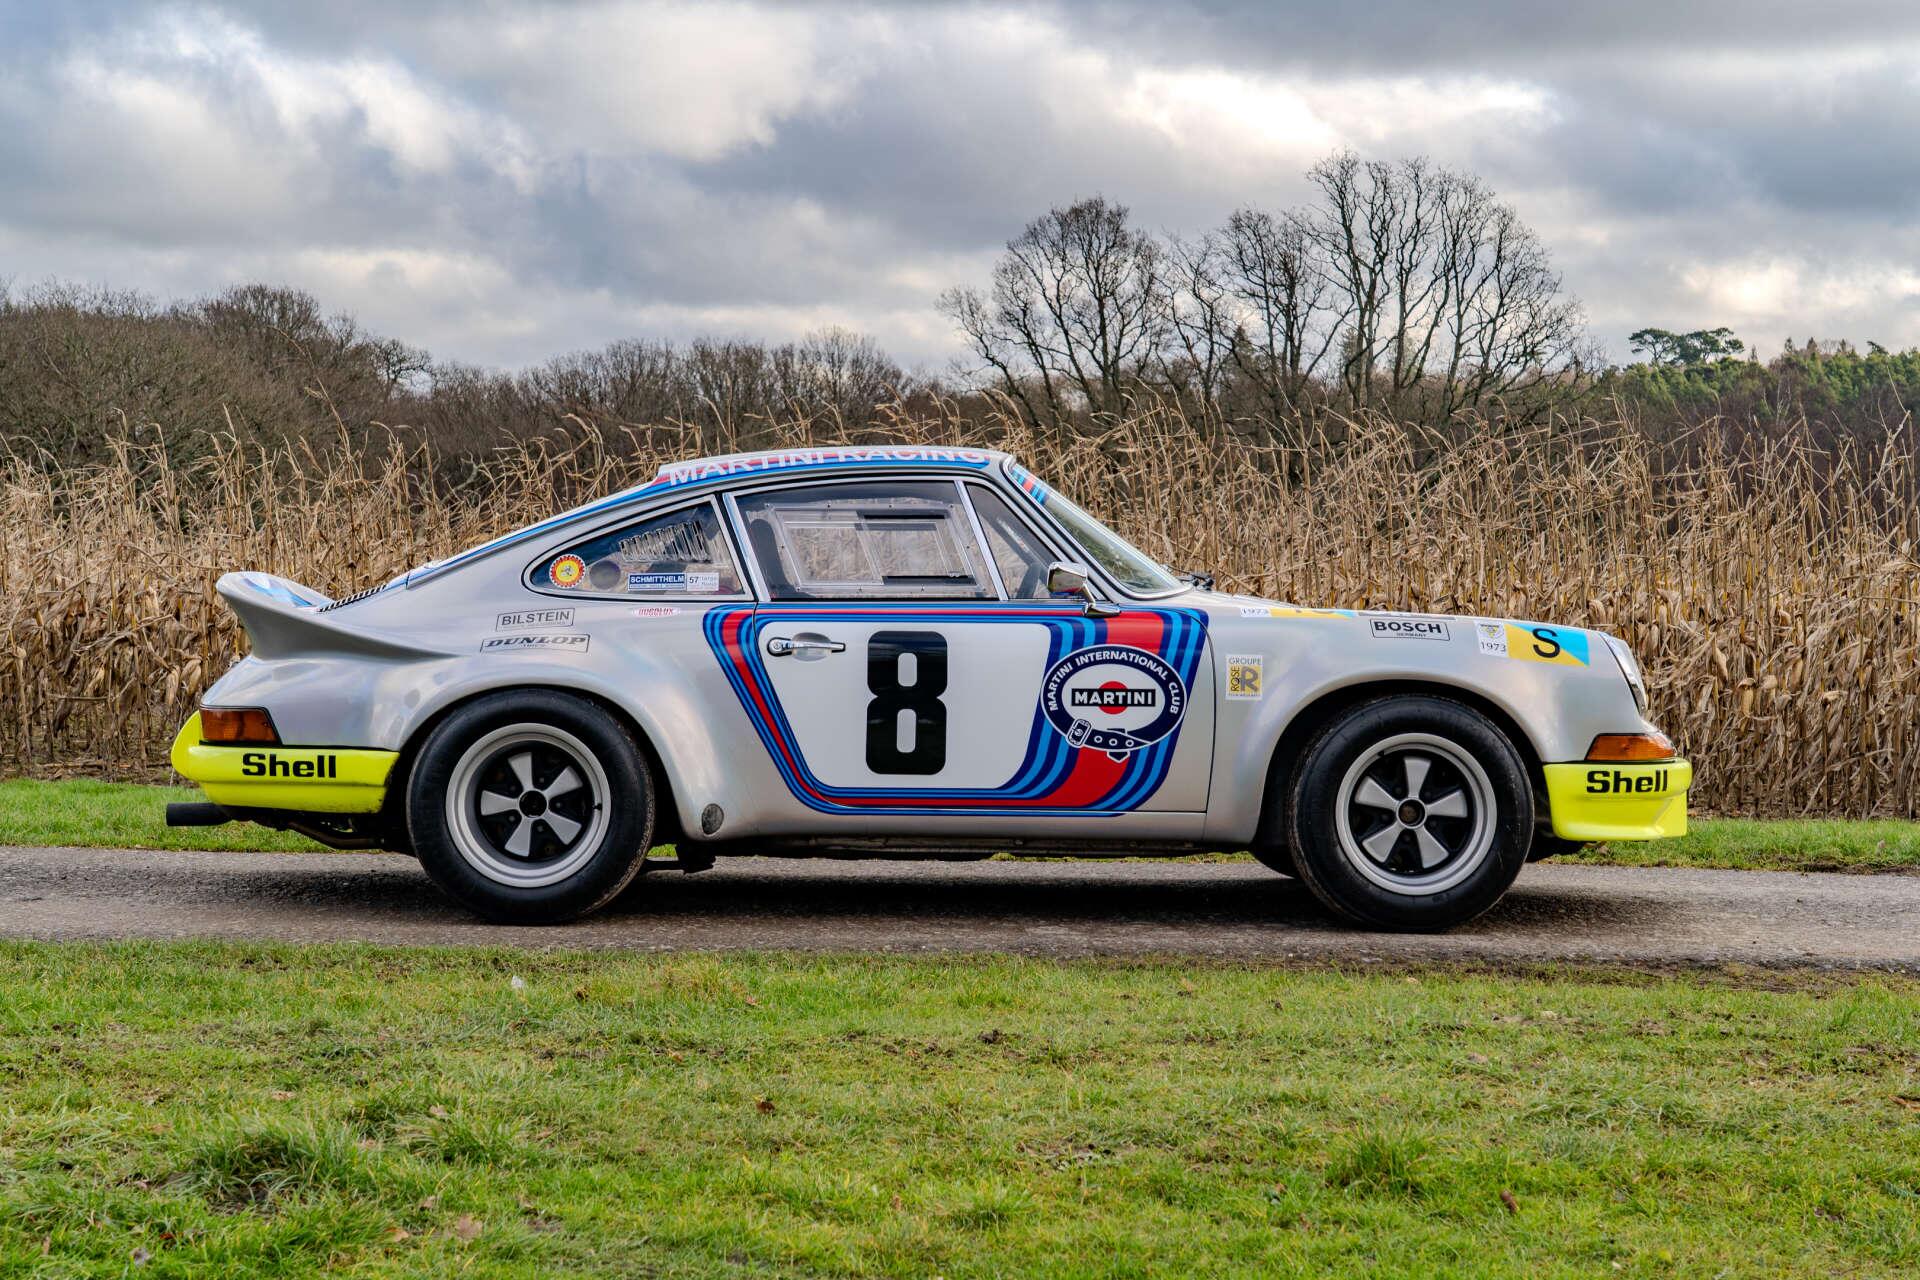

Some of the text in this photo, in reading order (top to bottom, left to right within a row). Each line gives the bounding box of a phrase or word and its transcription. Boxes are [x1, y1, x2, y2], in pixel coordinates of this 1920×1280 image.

[669, 449, 987, 486] MARTINI RACING
[630, 575, 684, 583] SCHMITTHELM
[689, 576, 699, 584] 57
[501, 611, 570, 626] BILSTEIN
[1374, 621, 1442, 634] BOSCH
[484, 637, 587, 648] DUNLOP
[1480, 641, 1507, 652] 1973
[1532, 628, 1561, 659] S
[1229, 657, 1262, 666] GROUPE
[1047, 650, 1181, 715] MARTINI INTERNATIONAL CLUB
[1230, 666, 1241, 692] ROSE
[866, 631, 947, 775] 8
[1074, 691, 1153, 705] MARTINI
[242, 753, 336, 778] Shell
[1587, 769, 1668, 793] Shell
